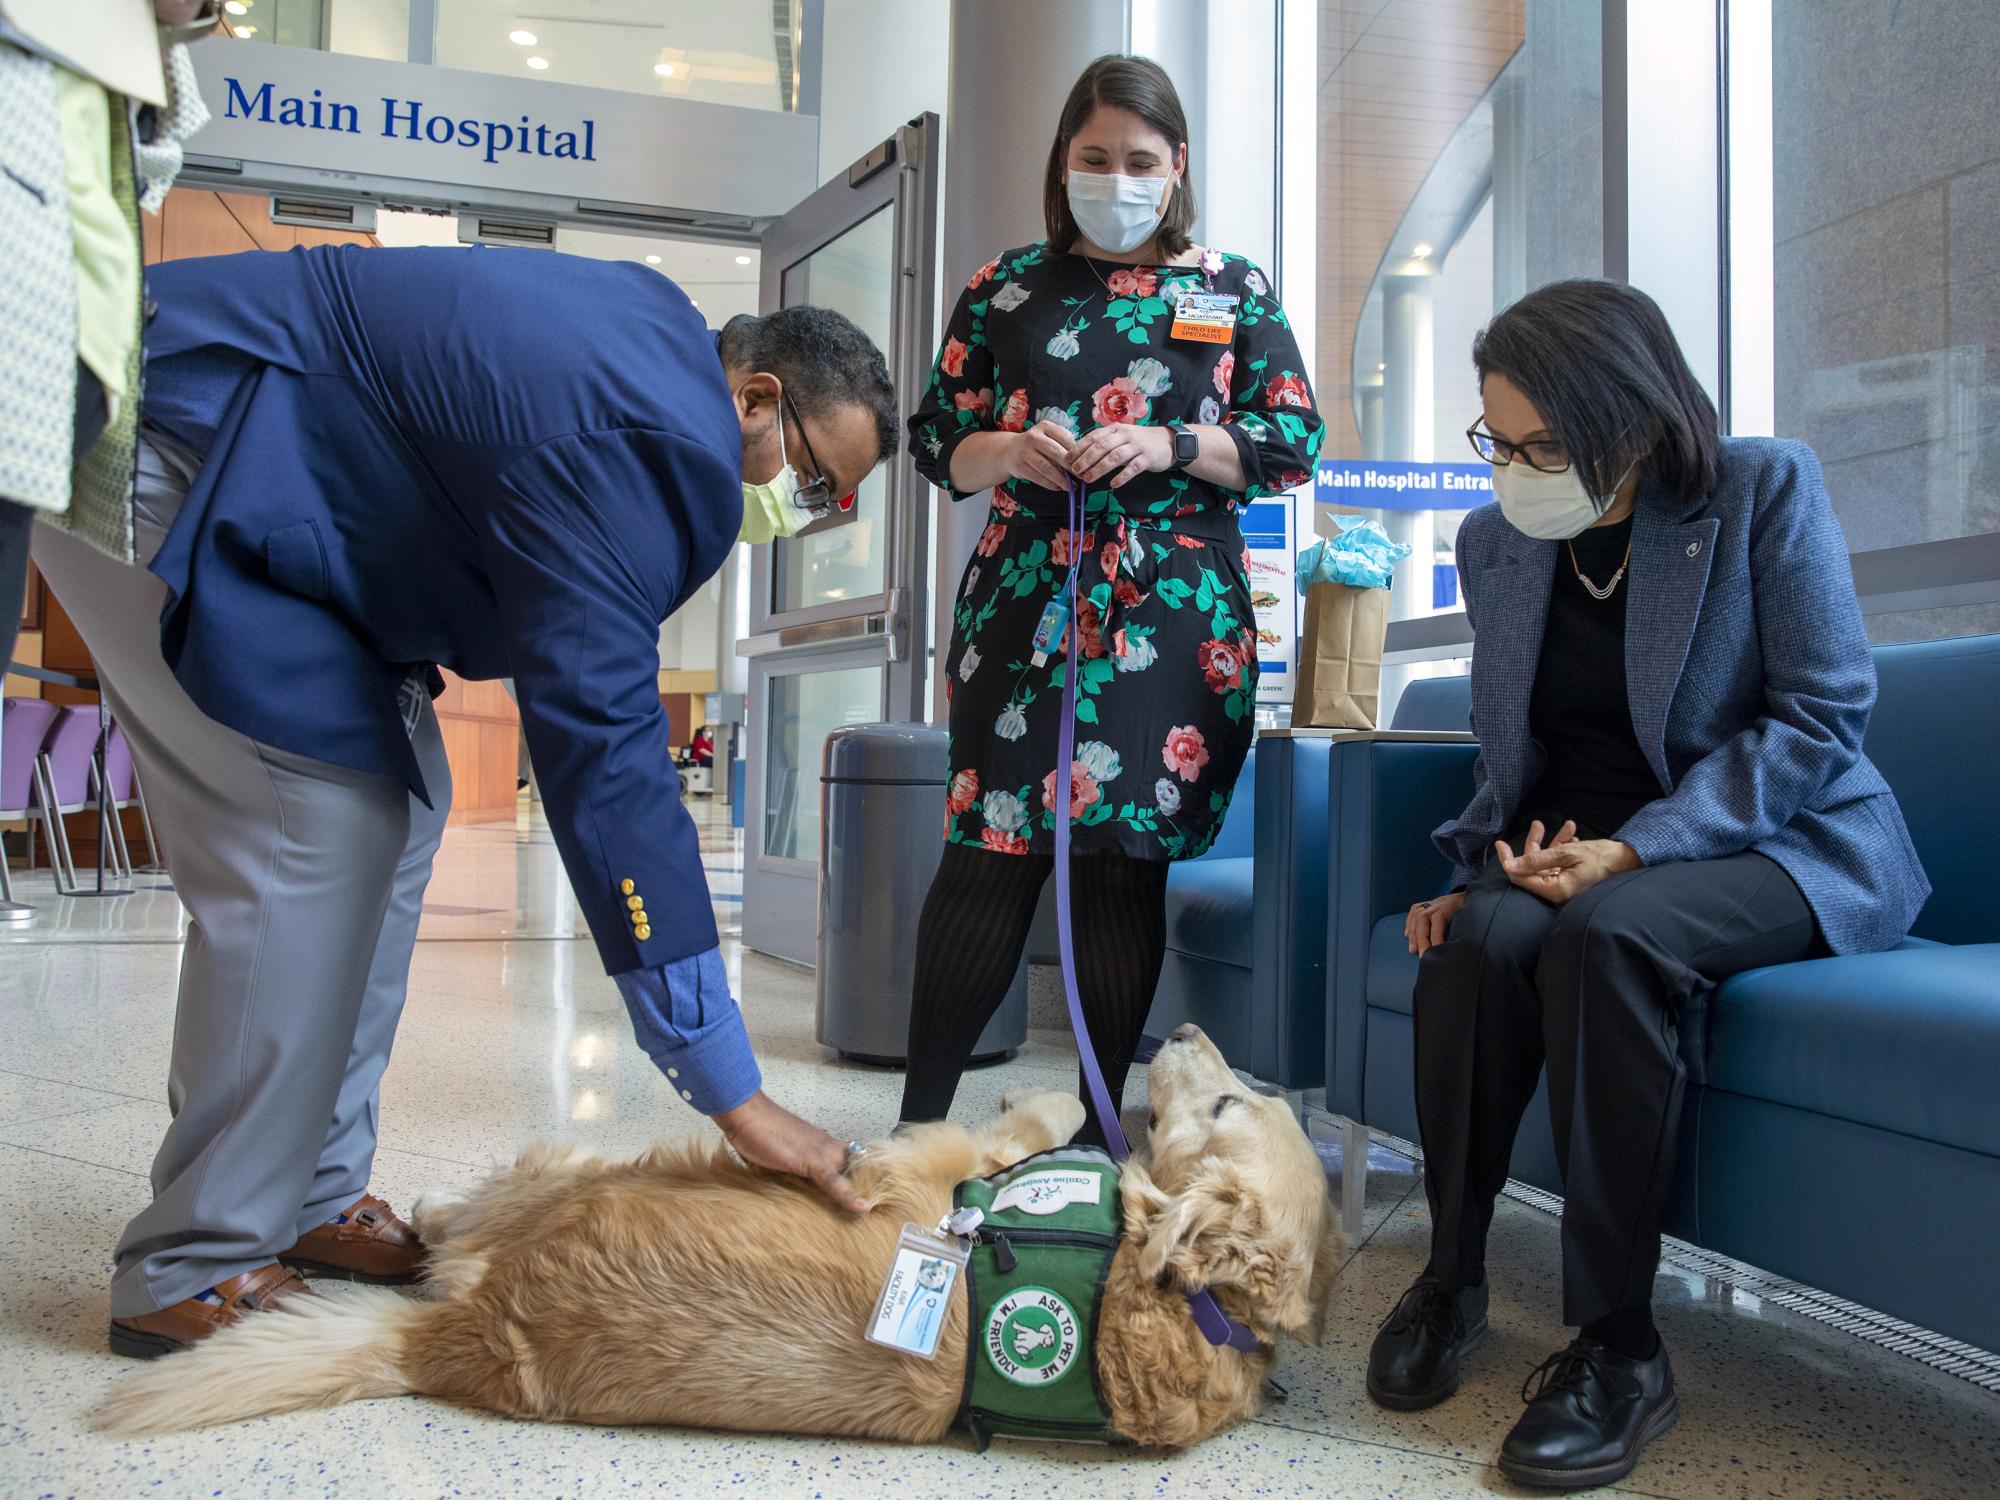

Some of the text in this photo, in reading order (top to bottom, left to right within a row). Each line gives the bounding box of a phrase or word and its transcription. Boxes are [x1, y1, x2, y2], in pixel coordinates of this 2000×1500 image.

[223, 77, 598, 164] Main Hospital
[1181, 331, 1222, 339] SPECIALIST
[1183, 325, 1222, 334] CHILD LIFE
[1317, 469, 1361, 488] Main
[1364, 470, 1437, 492] Hospital
[1053, 1176, 1091, 1185] Canine
[881, 1269, 904, 1320] FACILITY DOG
[990, 1298, 1019, 1375] I'M FRIENDLY
[1038, 1295, 1074, 1380] ASK TO PET ME
